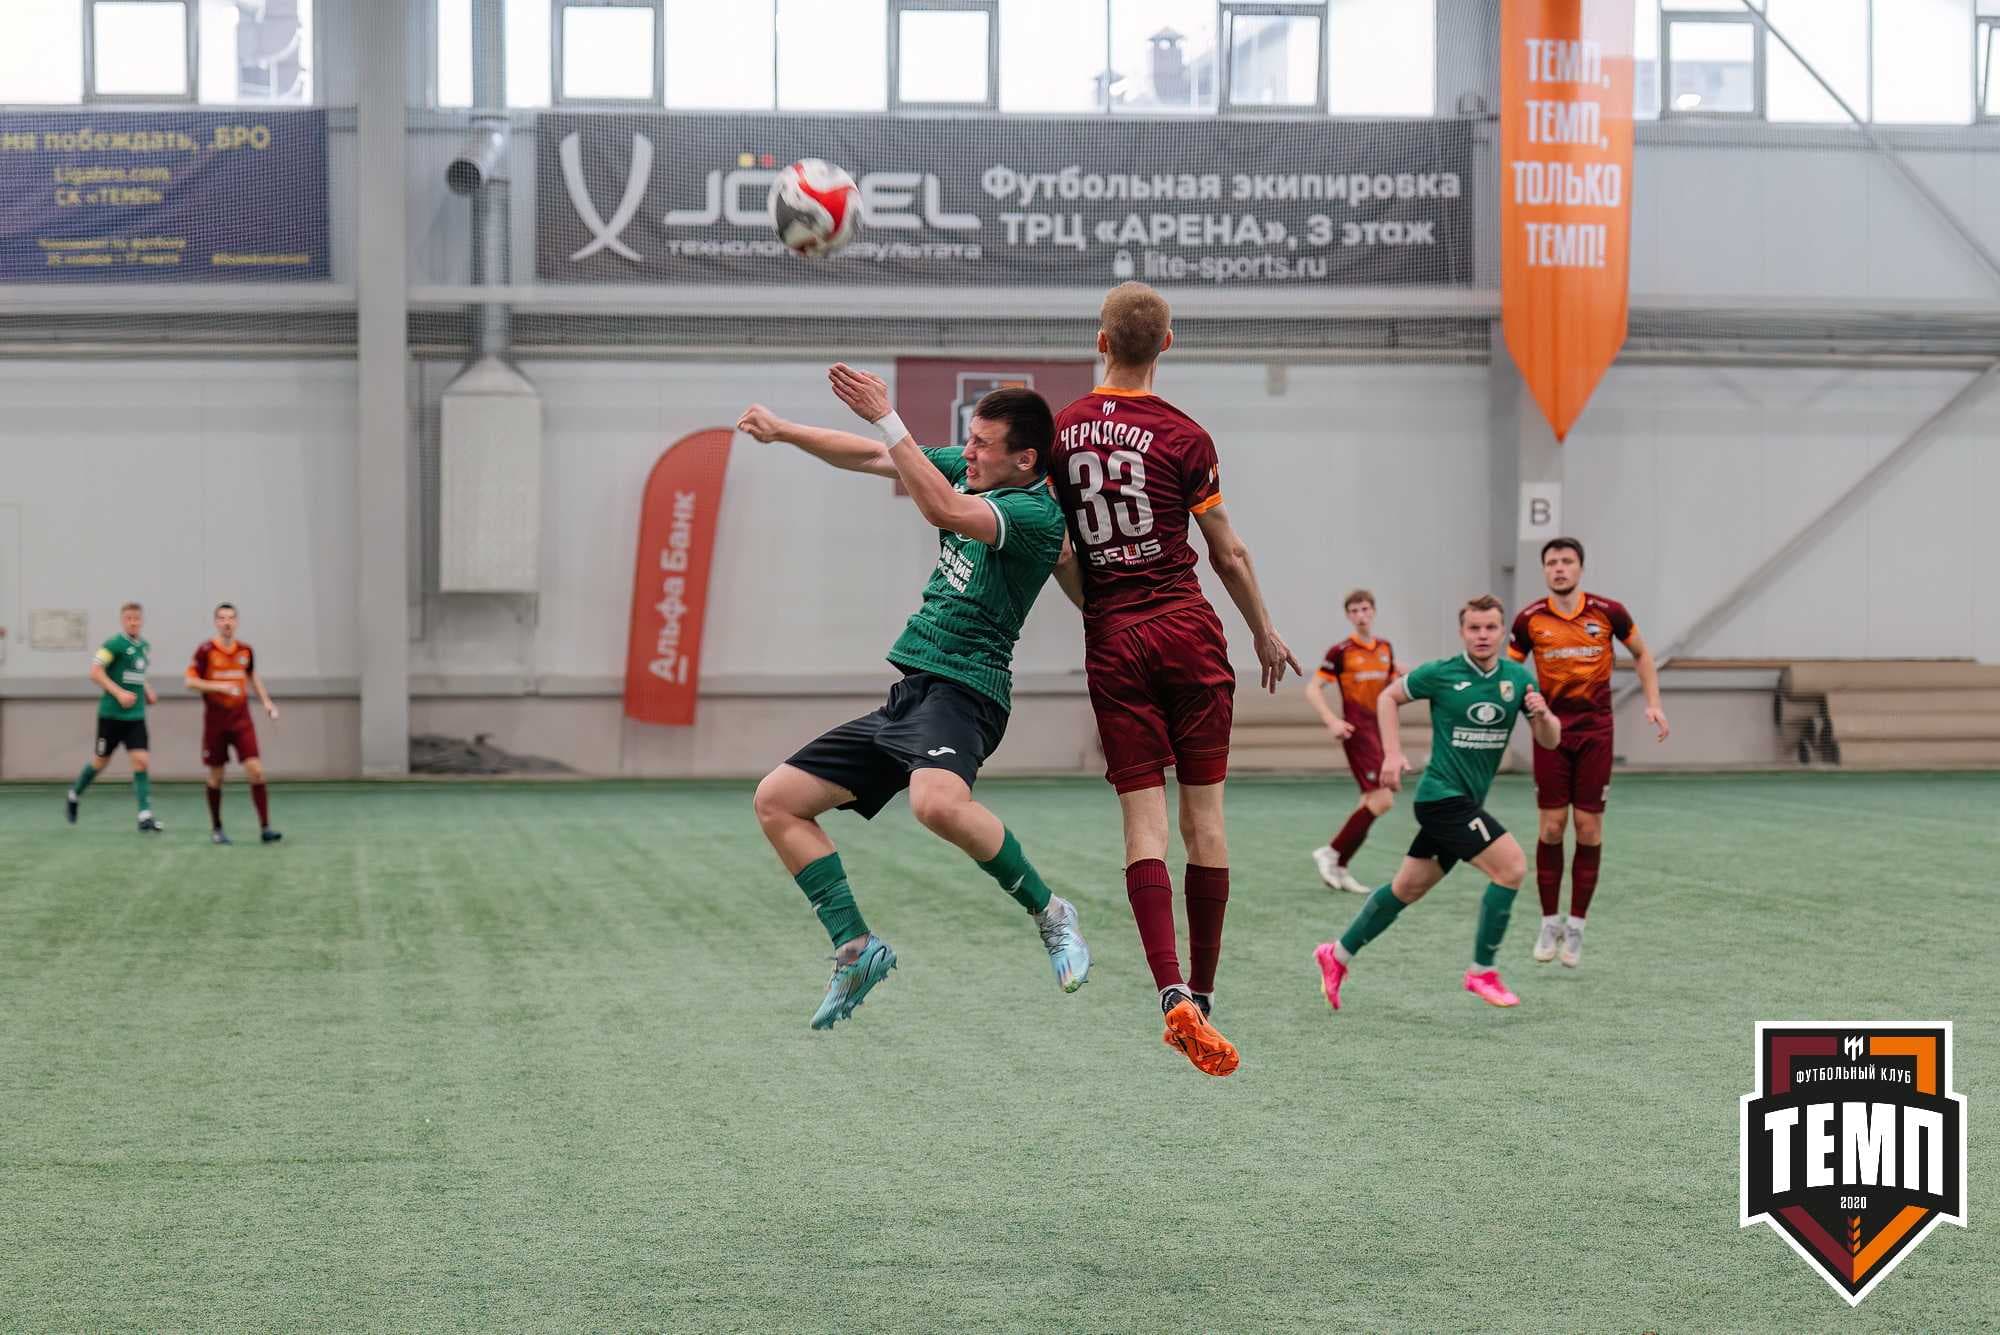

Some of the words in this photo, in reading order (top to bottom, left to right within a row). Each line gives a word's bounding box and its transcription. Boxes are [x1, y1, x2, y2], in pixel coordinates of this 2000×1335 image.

[1525, 37, 1611, 89] ТЕМП,
[1525, 100, 1609, 151] ТЕМП,
[981, 165, 1220, 206] Футбольная
[1232, 171, 1460, 206] экипировка
[1512, 160, 1621, 207] ТОЛЬКО
[998, 213, 1086, 250] ТРЦ
[1095, 212, 1298, 250] «АРЕНА»,
[1307, 213, 1332, 245] 3
[1344, 219, 1435, 245] этаж
[1525, 222, 1606, 268] ТЕМП!
[1143, 250, 1328, 280] lite-sports.ru
[1060, 420, 1154, 454] ЧЕРКАСОВ
[1068, 449, 1154, 545] 33
[660, 491, 697, 571] Банк
[1089, 538, 1162, 566] SEUS
[649, 577, 691, 683] Альфа
[1468, 816, 1491, 842] 7
